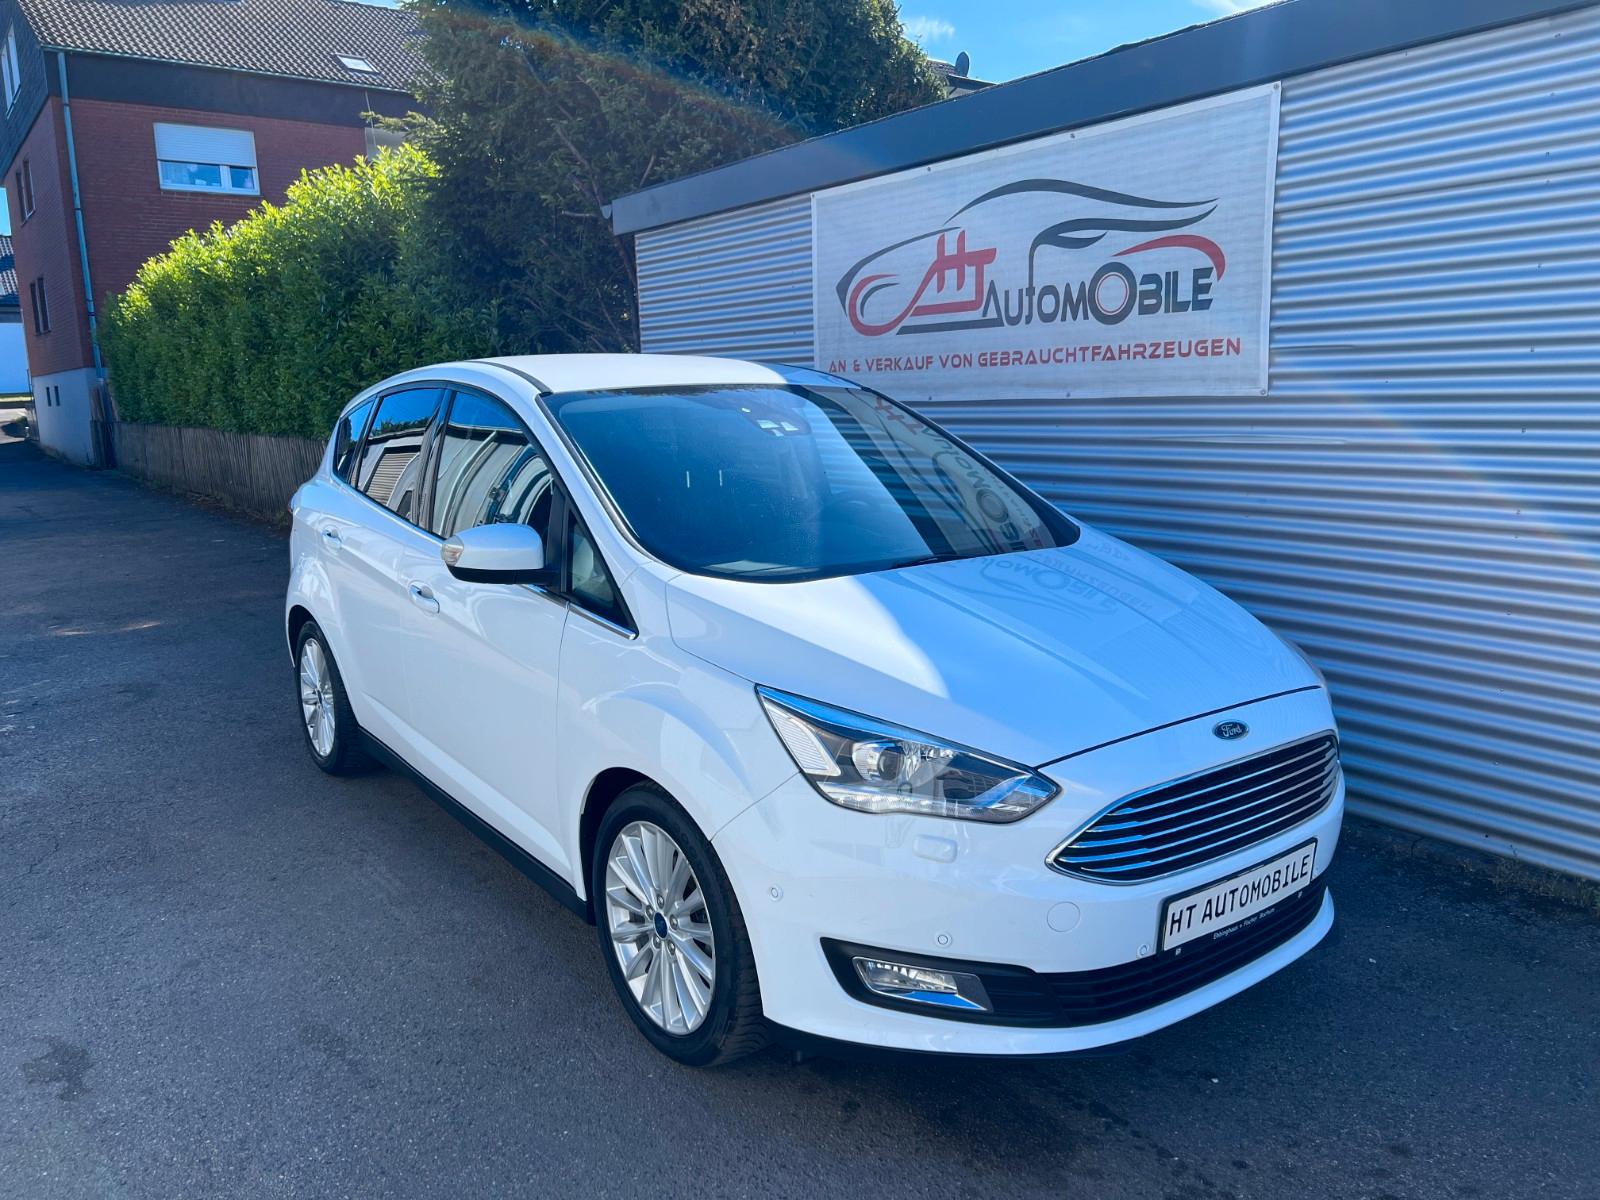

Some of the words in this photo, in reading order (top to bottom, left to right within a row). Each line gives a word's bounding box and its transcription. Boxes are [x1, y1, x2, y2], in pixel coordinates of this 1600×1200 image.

[980, 260, 1215, 328] AUTOMOBILE
[828, 360, 847, 373] AN
[852, 359, 861, 372] &
[865, 355, 934, 372] VERKAUF
[939, 353, 973, 368] VON
[977, 337, 1241, 368] GEBRAUCHTFAHRZEUGEN
[1169, 903, 1198, 937] HT
[1201, 854, 1311, 924] AUTOMOBILE
